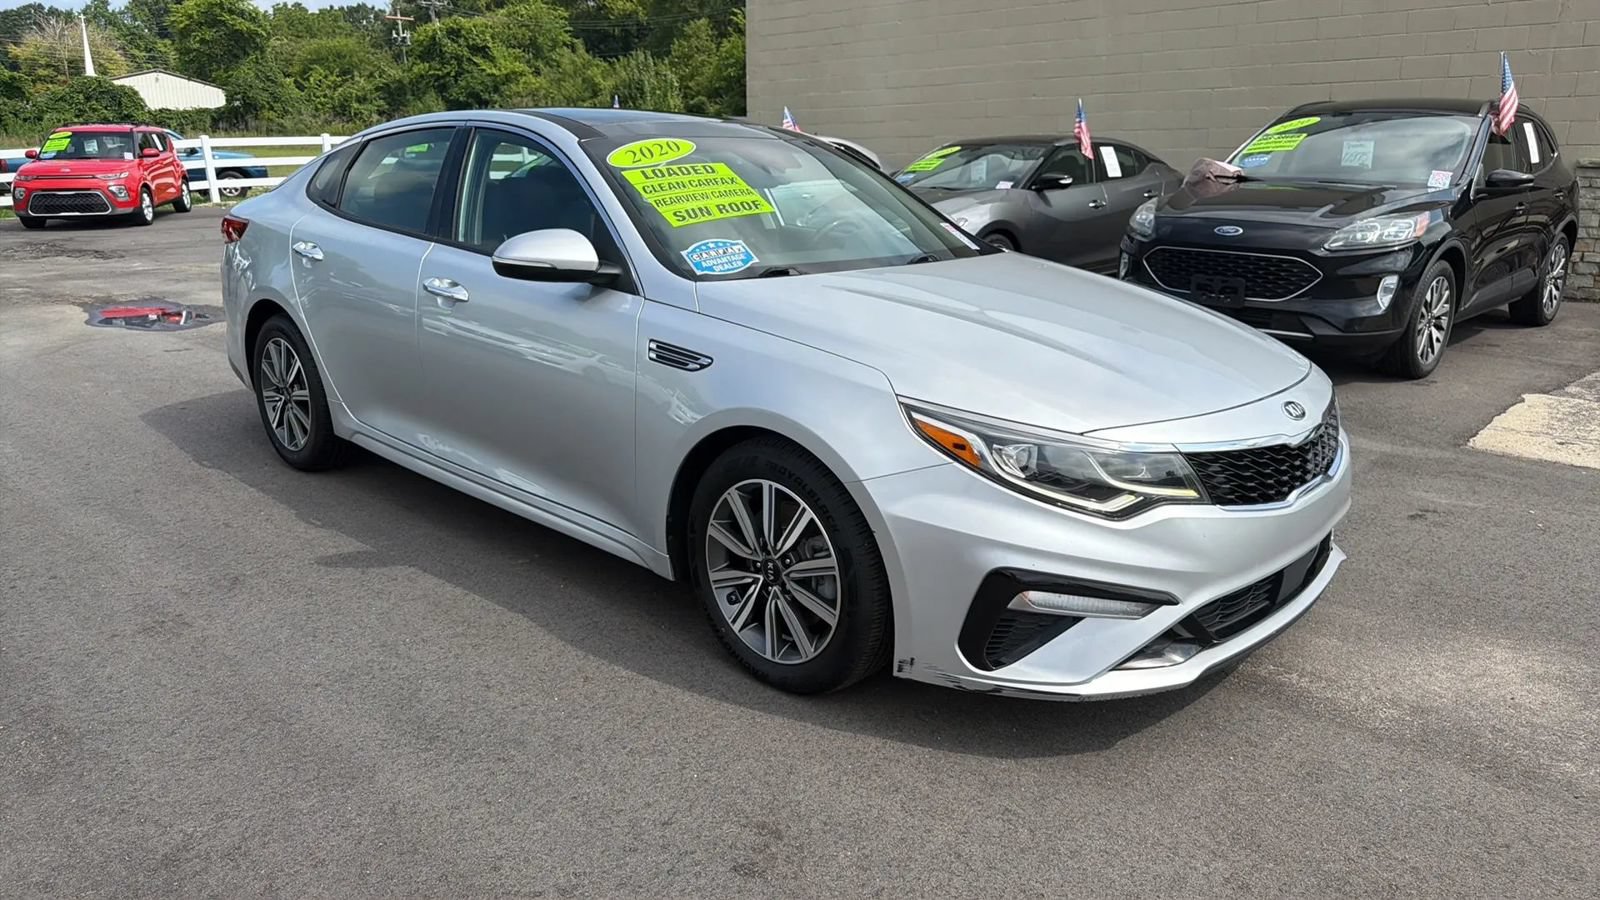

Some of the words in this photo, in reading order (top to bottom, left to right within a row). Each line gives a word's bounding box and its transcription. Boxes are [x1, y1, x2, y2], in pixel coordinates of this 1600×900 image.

[625, 140, 681, 164] 2020
[640, 165, 717, 180] LOADED
[642, 180, 686, 195] CLEAN
[688, 176, 738, 190] CARFAX
[654, 191, 710, 208] REARVIEW
[711, 187, 754, 200] CAMERA
[672, 205, 712, 222] SUN
[716, 200, 762, 215] ROOF
[701, 253, 748, 268] ADVANTAGE
[713, 260, 745, 272] DEALER
[767, 562, 775, 580] KIA
